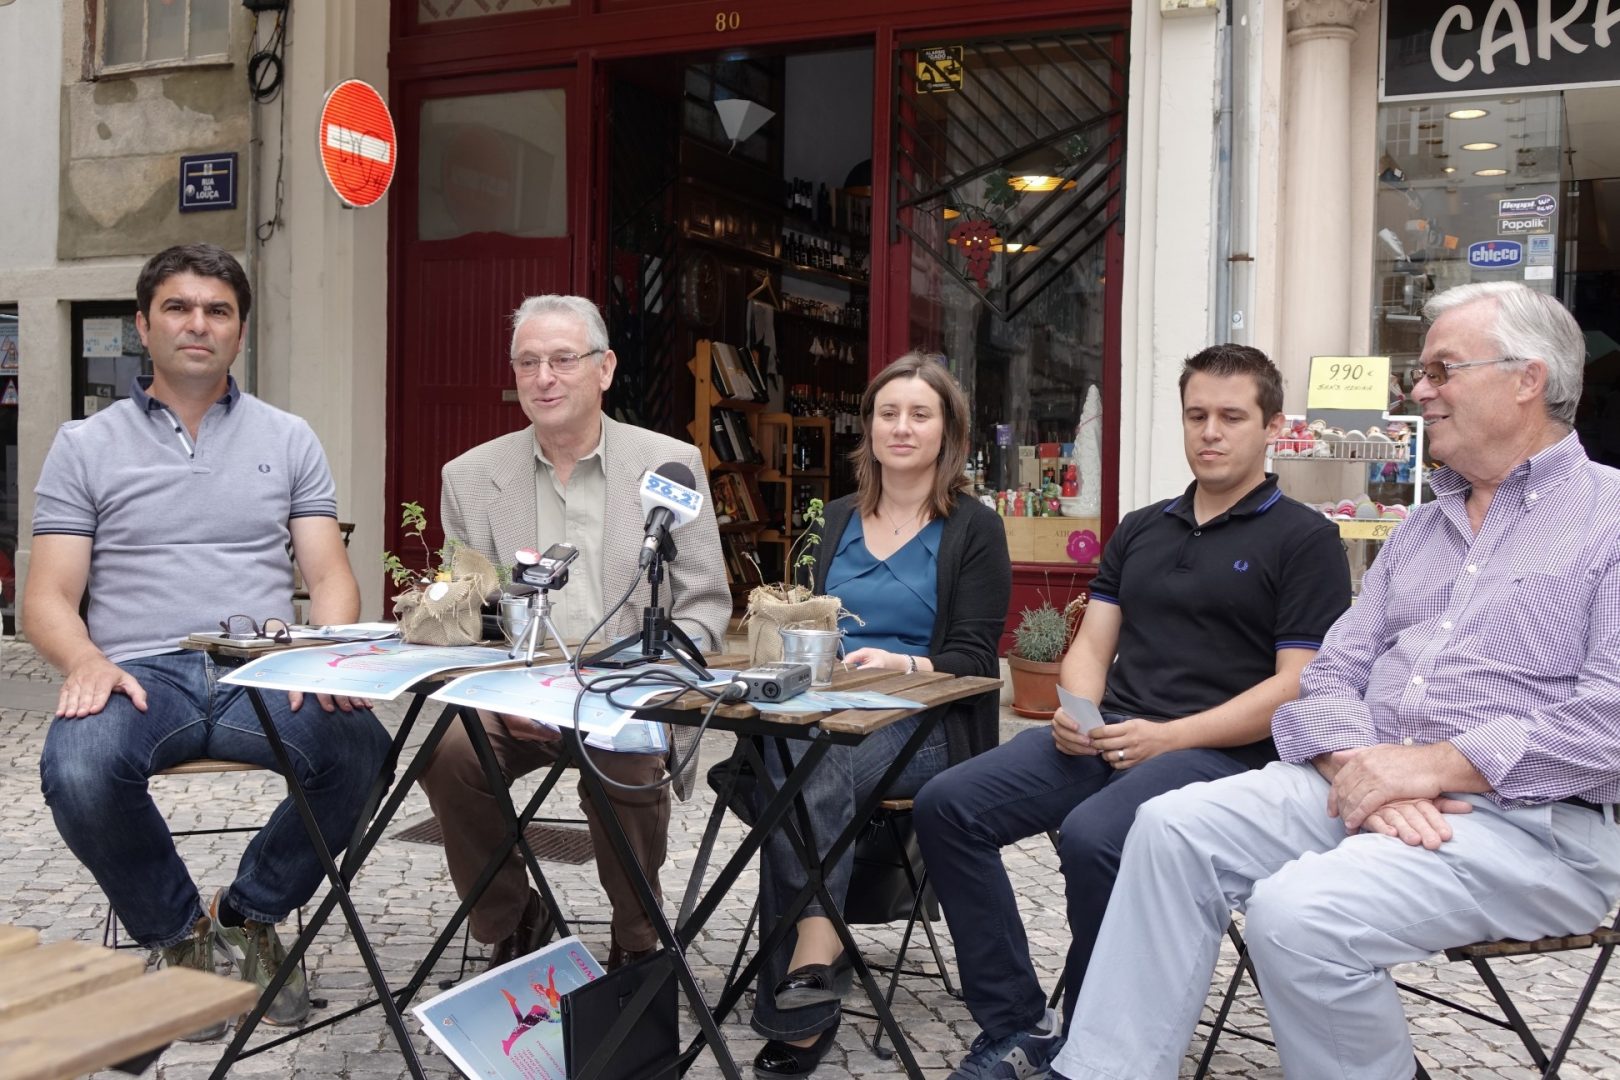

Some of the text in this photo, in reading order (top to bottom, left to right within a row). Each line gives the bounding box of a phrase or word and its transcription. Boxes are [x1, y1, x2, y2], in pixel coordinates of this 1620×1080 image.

[715, 11, 740, 31] 80
[201, 178, 215, 186] RUA
[196, 190, 219, 200] LOUÇA
[1502, 219, 1544, 230] Papalik
[1472, 242, 1518, 263] chicco
